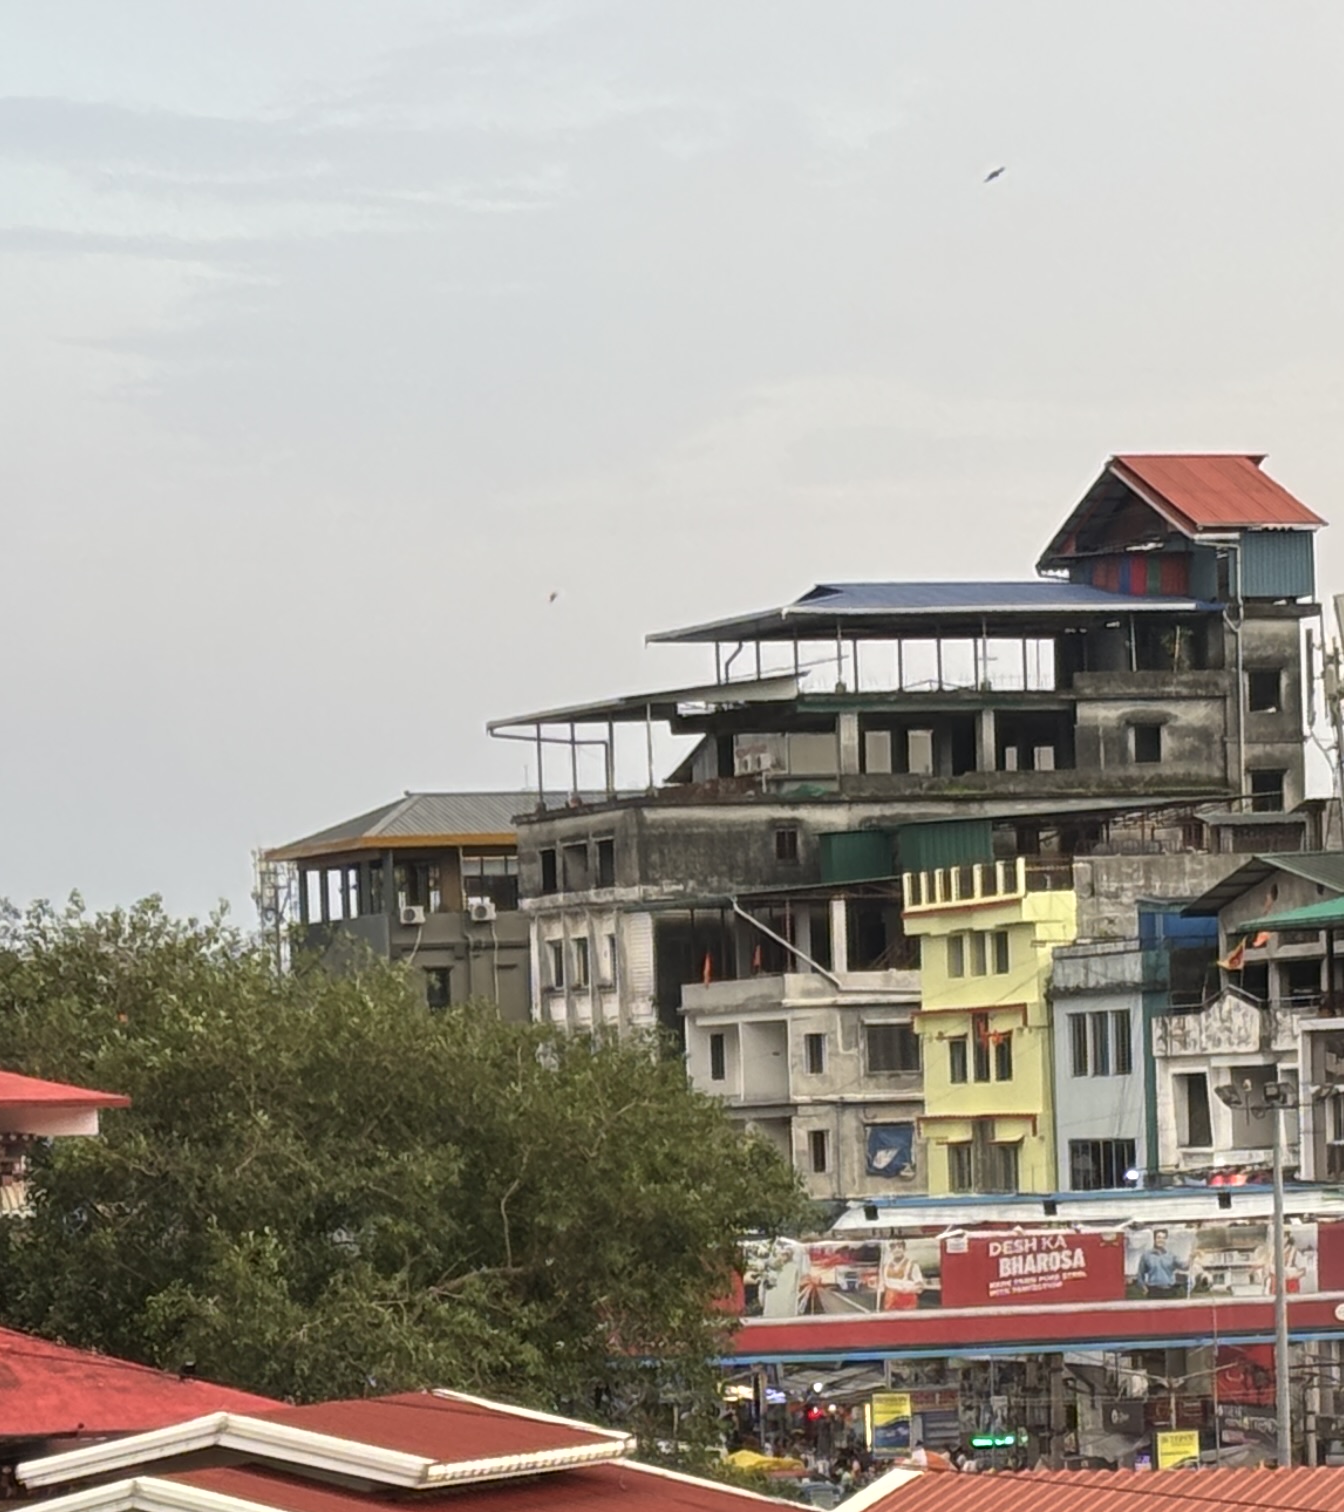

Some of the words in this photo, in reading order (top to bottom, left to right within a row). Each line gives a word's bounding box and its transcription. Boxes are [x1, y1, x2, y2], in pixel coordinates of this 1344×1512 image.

[989, 1238, 1038, 1257] DESH
[1041, 1234, 1067, 1251] KA
[999, 1248, 1086, 1278] BHAROSA
